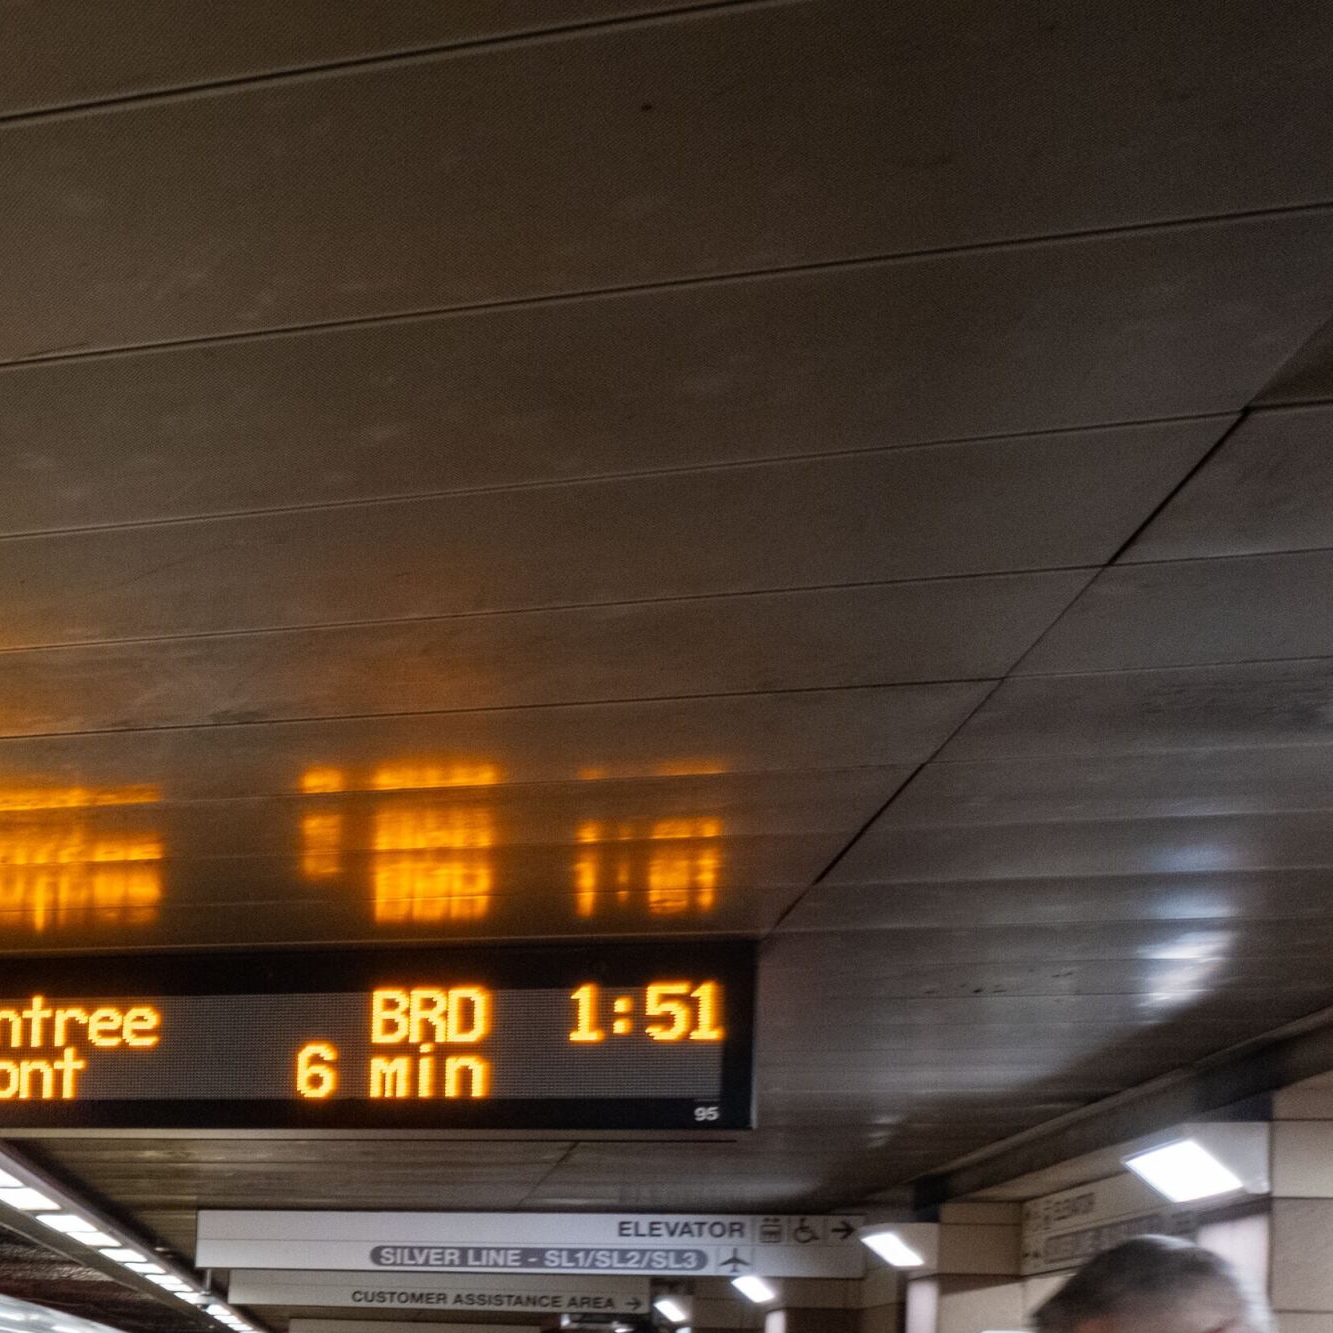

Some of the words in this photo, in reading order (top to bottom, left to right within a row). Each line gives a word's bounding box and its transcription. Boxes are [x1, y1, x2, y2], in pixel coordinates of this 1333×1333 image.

[370, 985, 489, 1044] BRD
[568, 981, 725, 1042] 1:51
[296, 1041, 338, 1099] 6
[369, 1042, 490, 1099] min
[693, 1106, 720, 1121] 95
[617, 1221, 746, 1239] ELEVATOR
[379, 1247, 461, 1266] SILVER
[466, 1249, 522, 1267] LINE
[543, 1250, 699, 1270] SL1/SL2/SL3
[351, 1290, 449, 1305] CUSTOMER
[452, 1292, 562, 1309] ASSISTANCE
[566, 1296, 616, 1310] AREA
